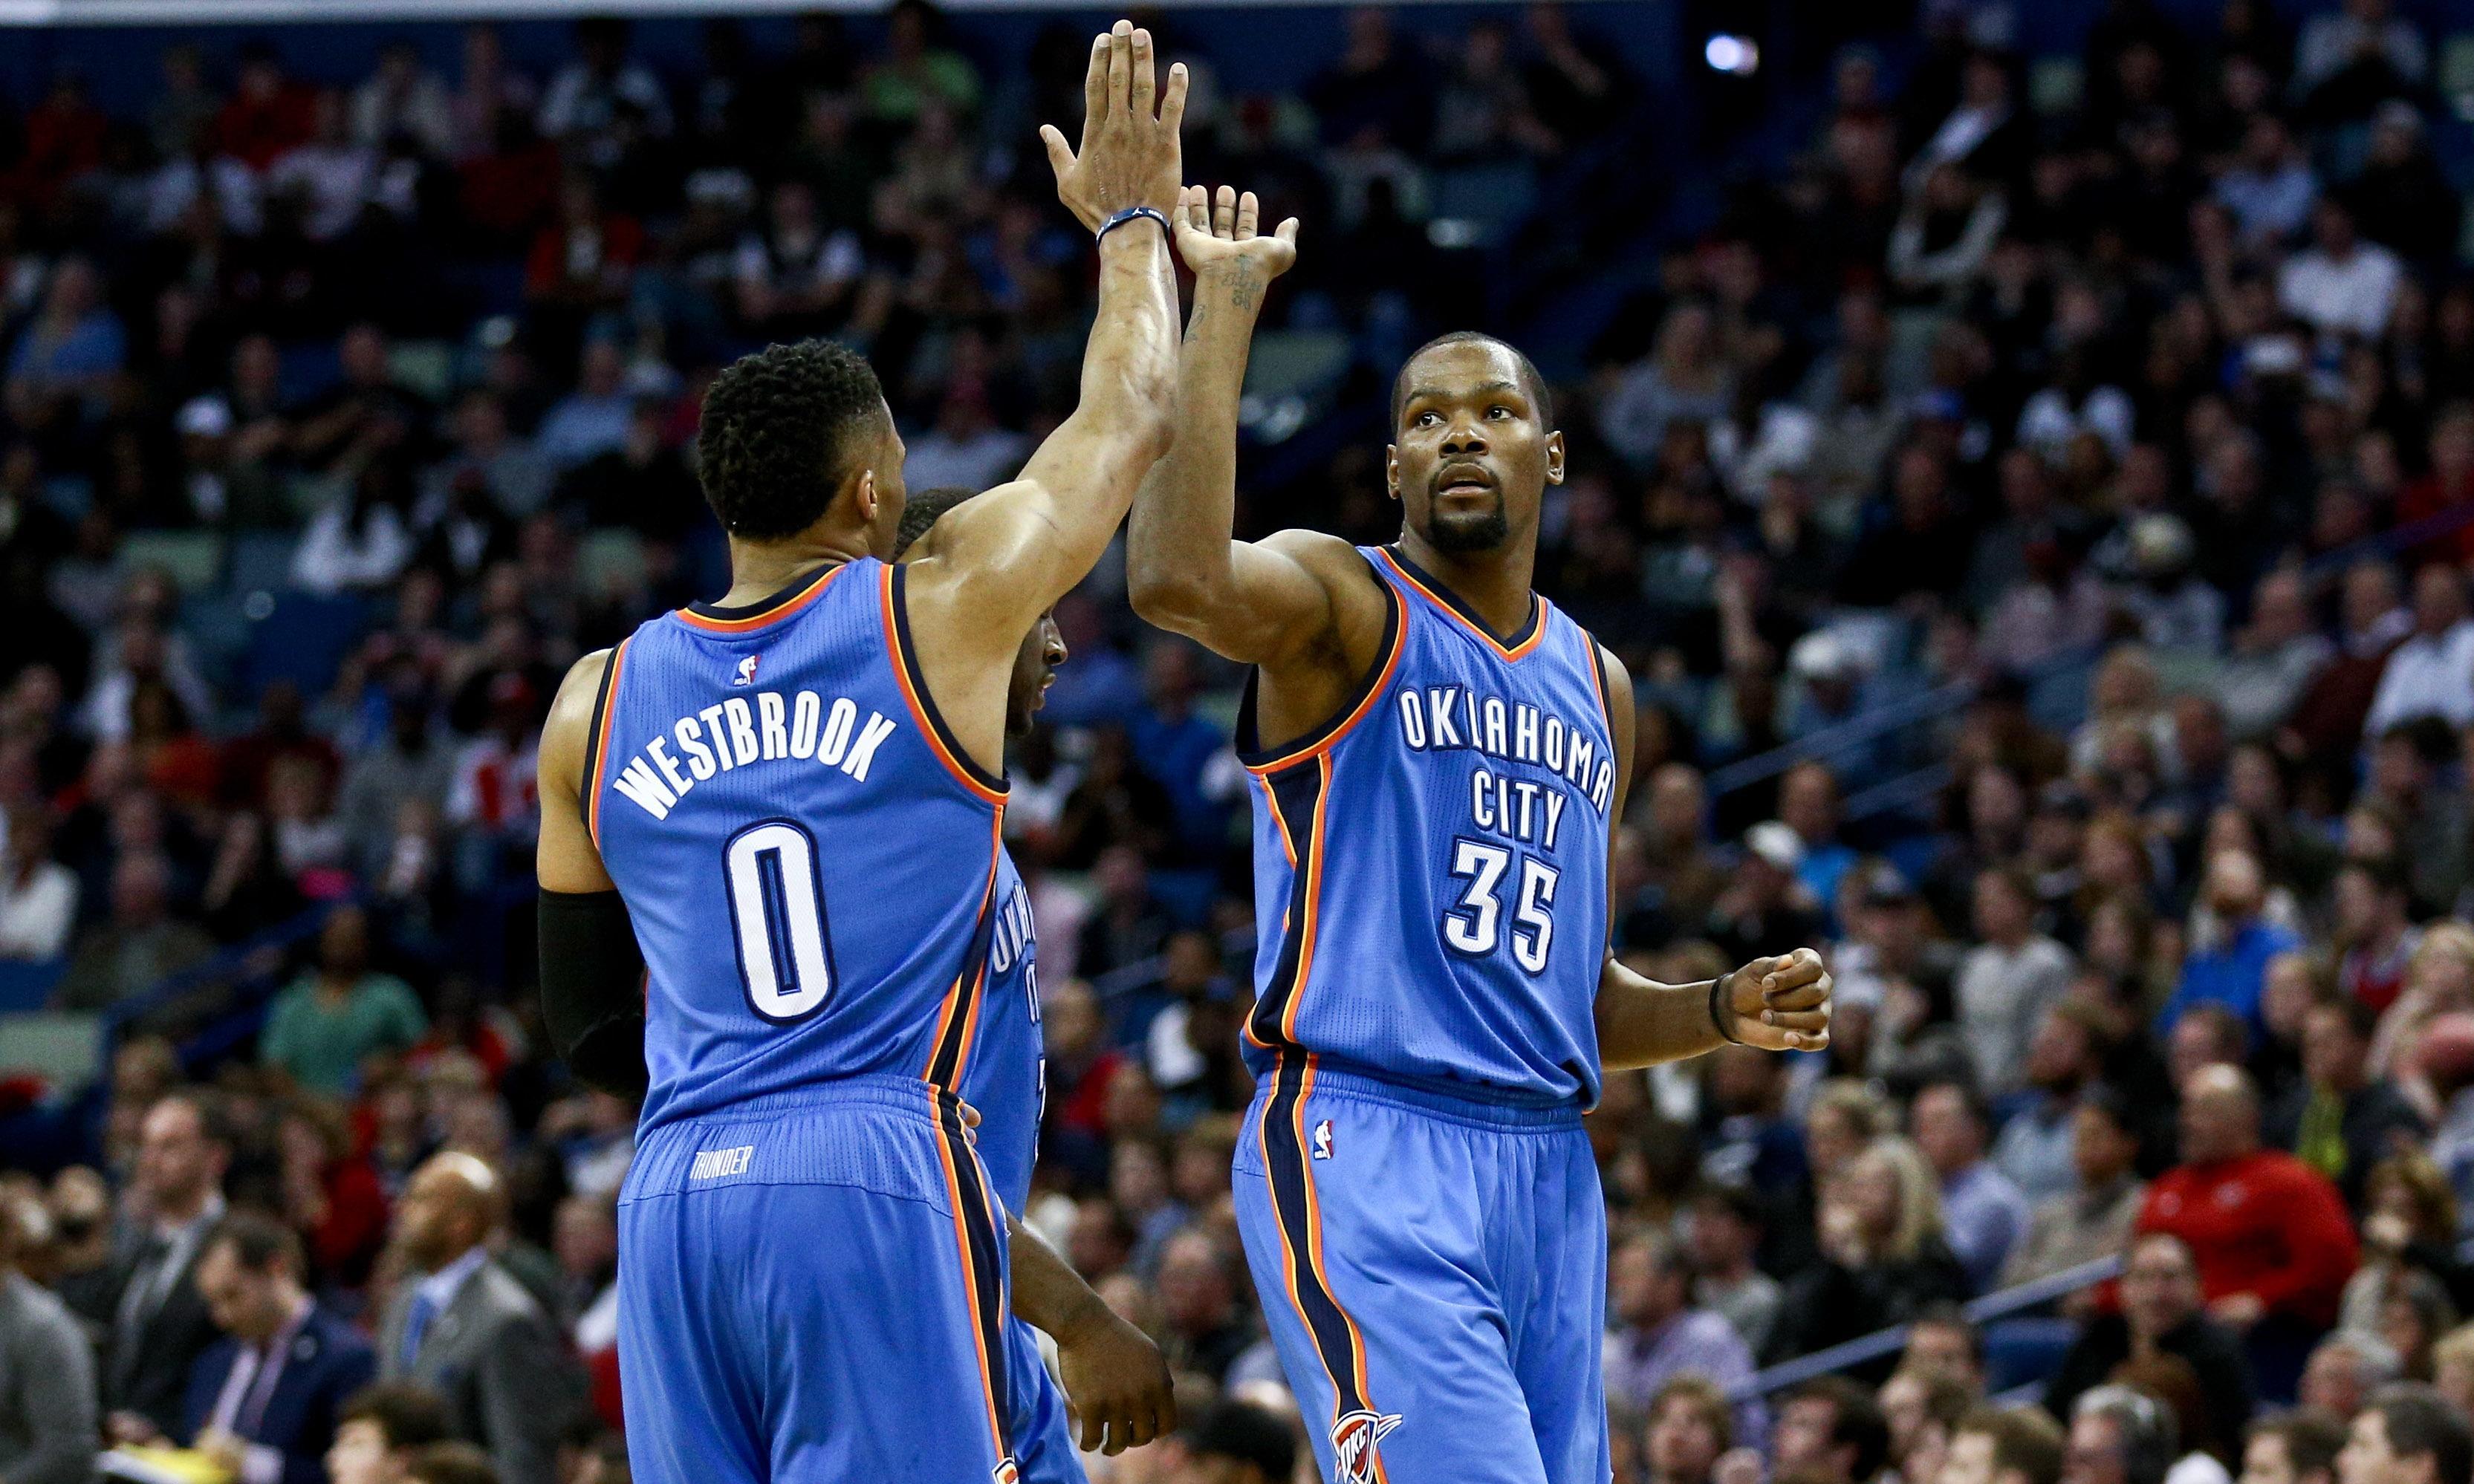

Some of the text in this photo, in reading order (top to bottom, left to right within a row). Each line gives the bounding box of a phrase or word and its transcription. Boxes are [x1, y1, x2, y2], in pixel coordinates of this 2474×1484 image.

[613, 690, 896, 821] WESTBROOK
[1397, 683, 1614, 819] OKLAHOMA
[1470, 765, 1567, 853] CITY
[724, 817, 837, 1025] 0
[1443, 835, 1560, 977] 35
[689, 1145, 753, 1179] THUNDER
[1340, 1423, 1367, 1484] OKC
